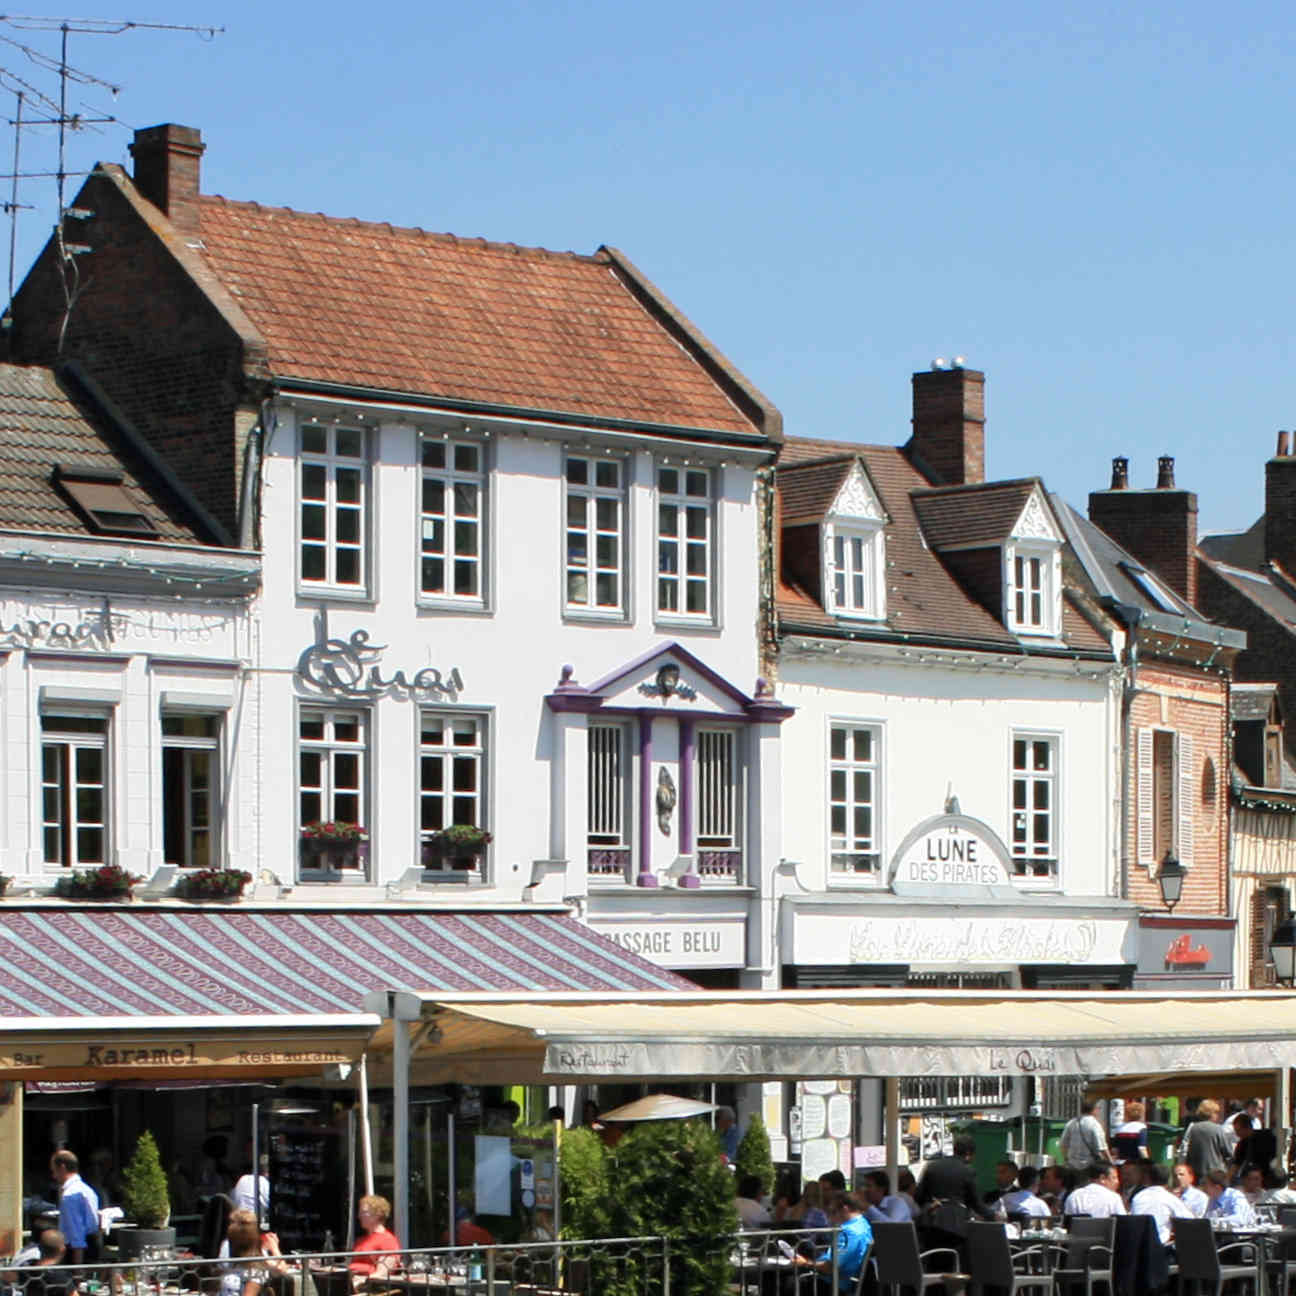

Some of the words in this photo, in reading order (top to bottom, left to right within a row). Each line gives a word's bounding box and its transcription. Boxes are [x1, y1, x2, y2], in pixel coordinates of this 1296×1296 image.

[314, 602, 388, 655] Le
[927, 838, 977, 862] LUNE
[910, 862, 937, 881] DES
[943, 864, 999, 884] PIRATES
[683, 931, 721, 953] BELU
[13, 1052, 43, 1067] Bar
[85, 1043, 199, 1066] Karamel
[238, 1050, 346, 1064] Restaurant
[990, 1049, 1008, 1070] Le
